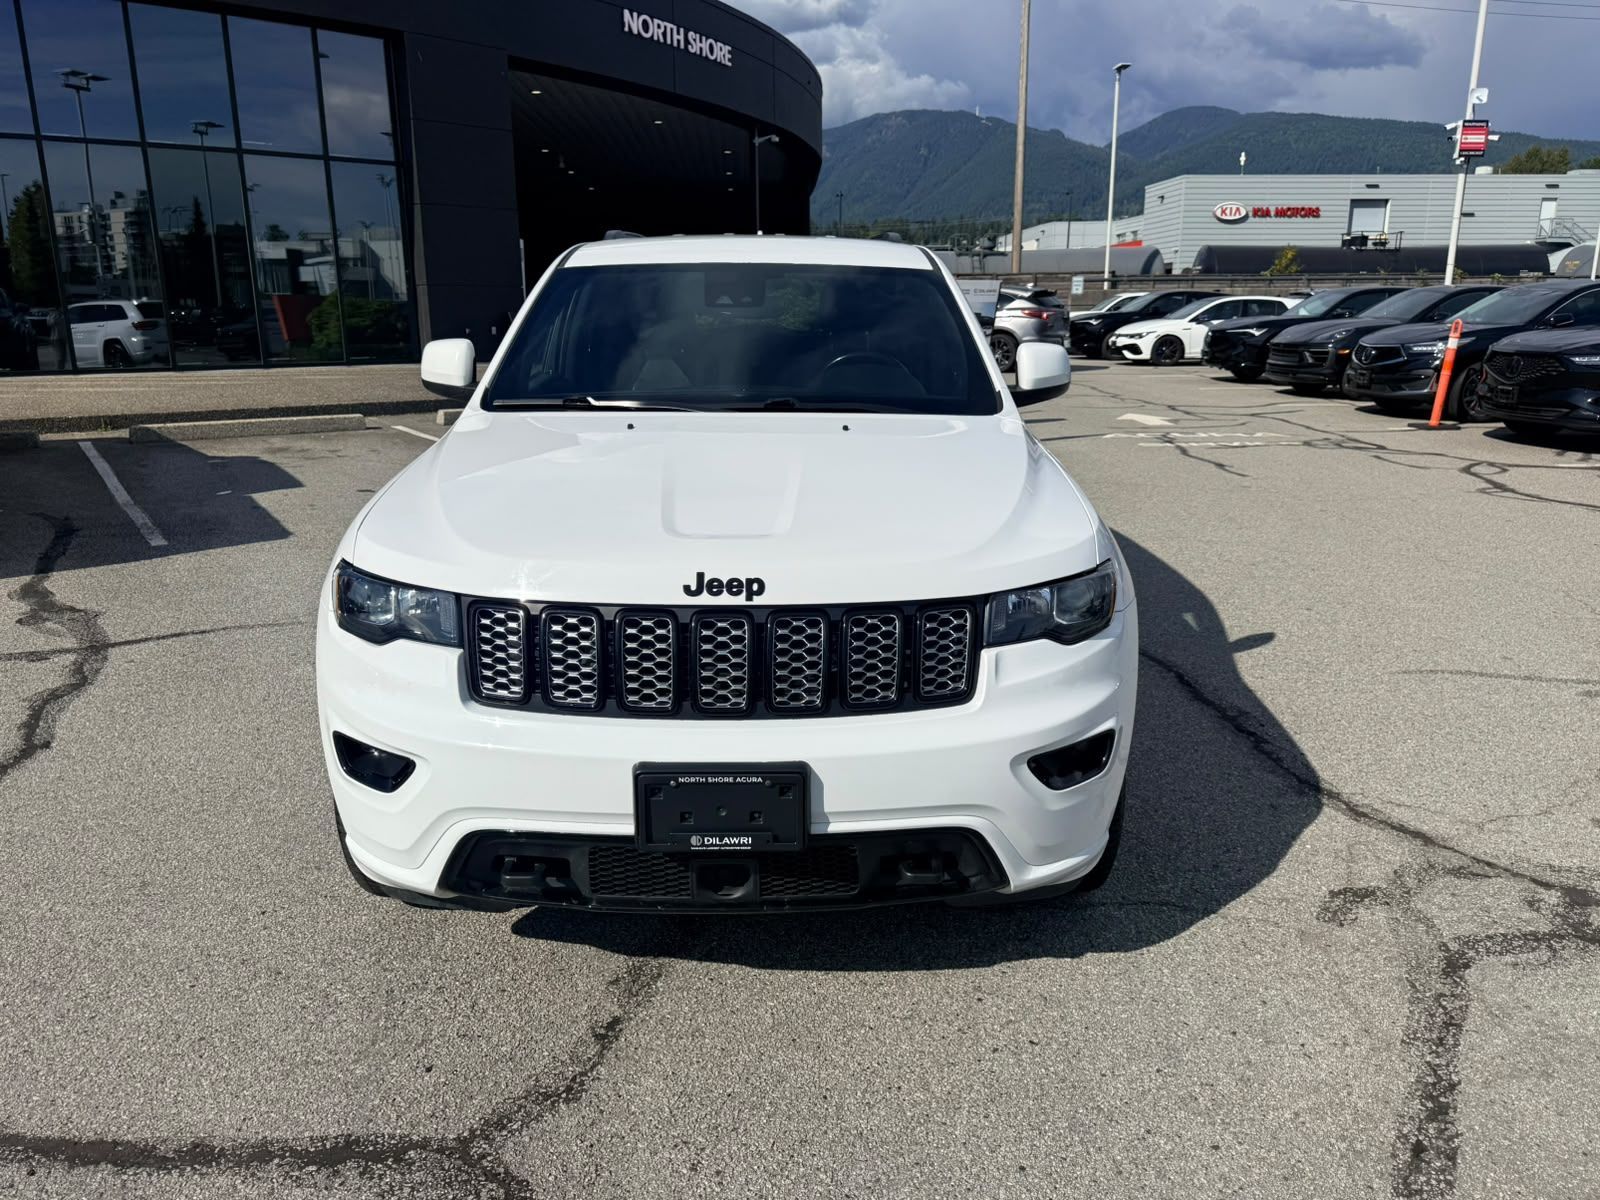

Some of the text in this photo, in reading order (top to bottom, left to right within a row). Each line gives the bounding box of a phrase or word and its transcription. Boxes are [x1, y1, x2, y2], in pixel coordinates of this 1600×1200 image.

[623, 8, 732, 67] NORTH SHORE
[1252, 207, 1321, 218] KIA MOTORS
[683, 572, 765, 602] Jeep
[704, 836, 752, 845] DILAWRI
